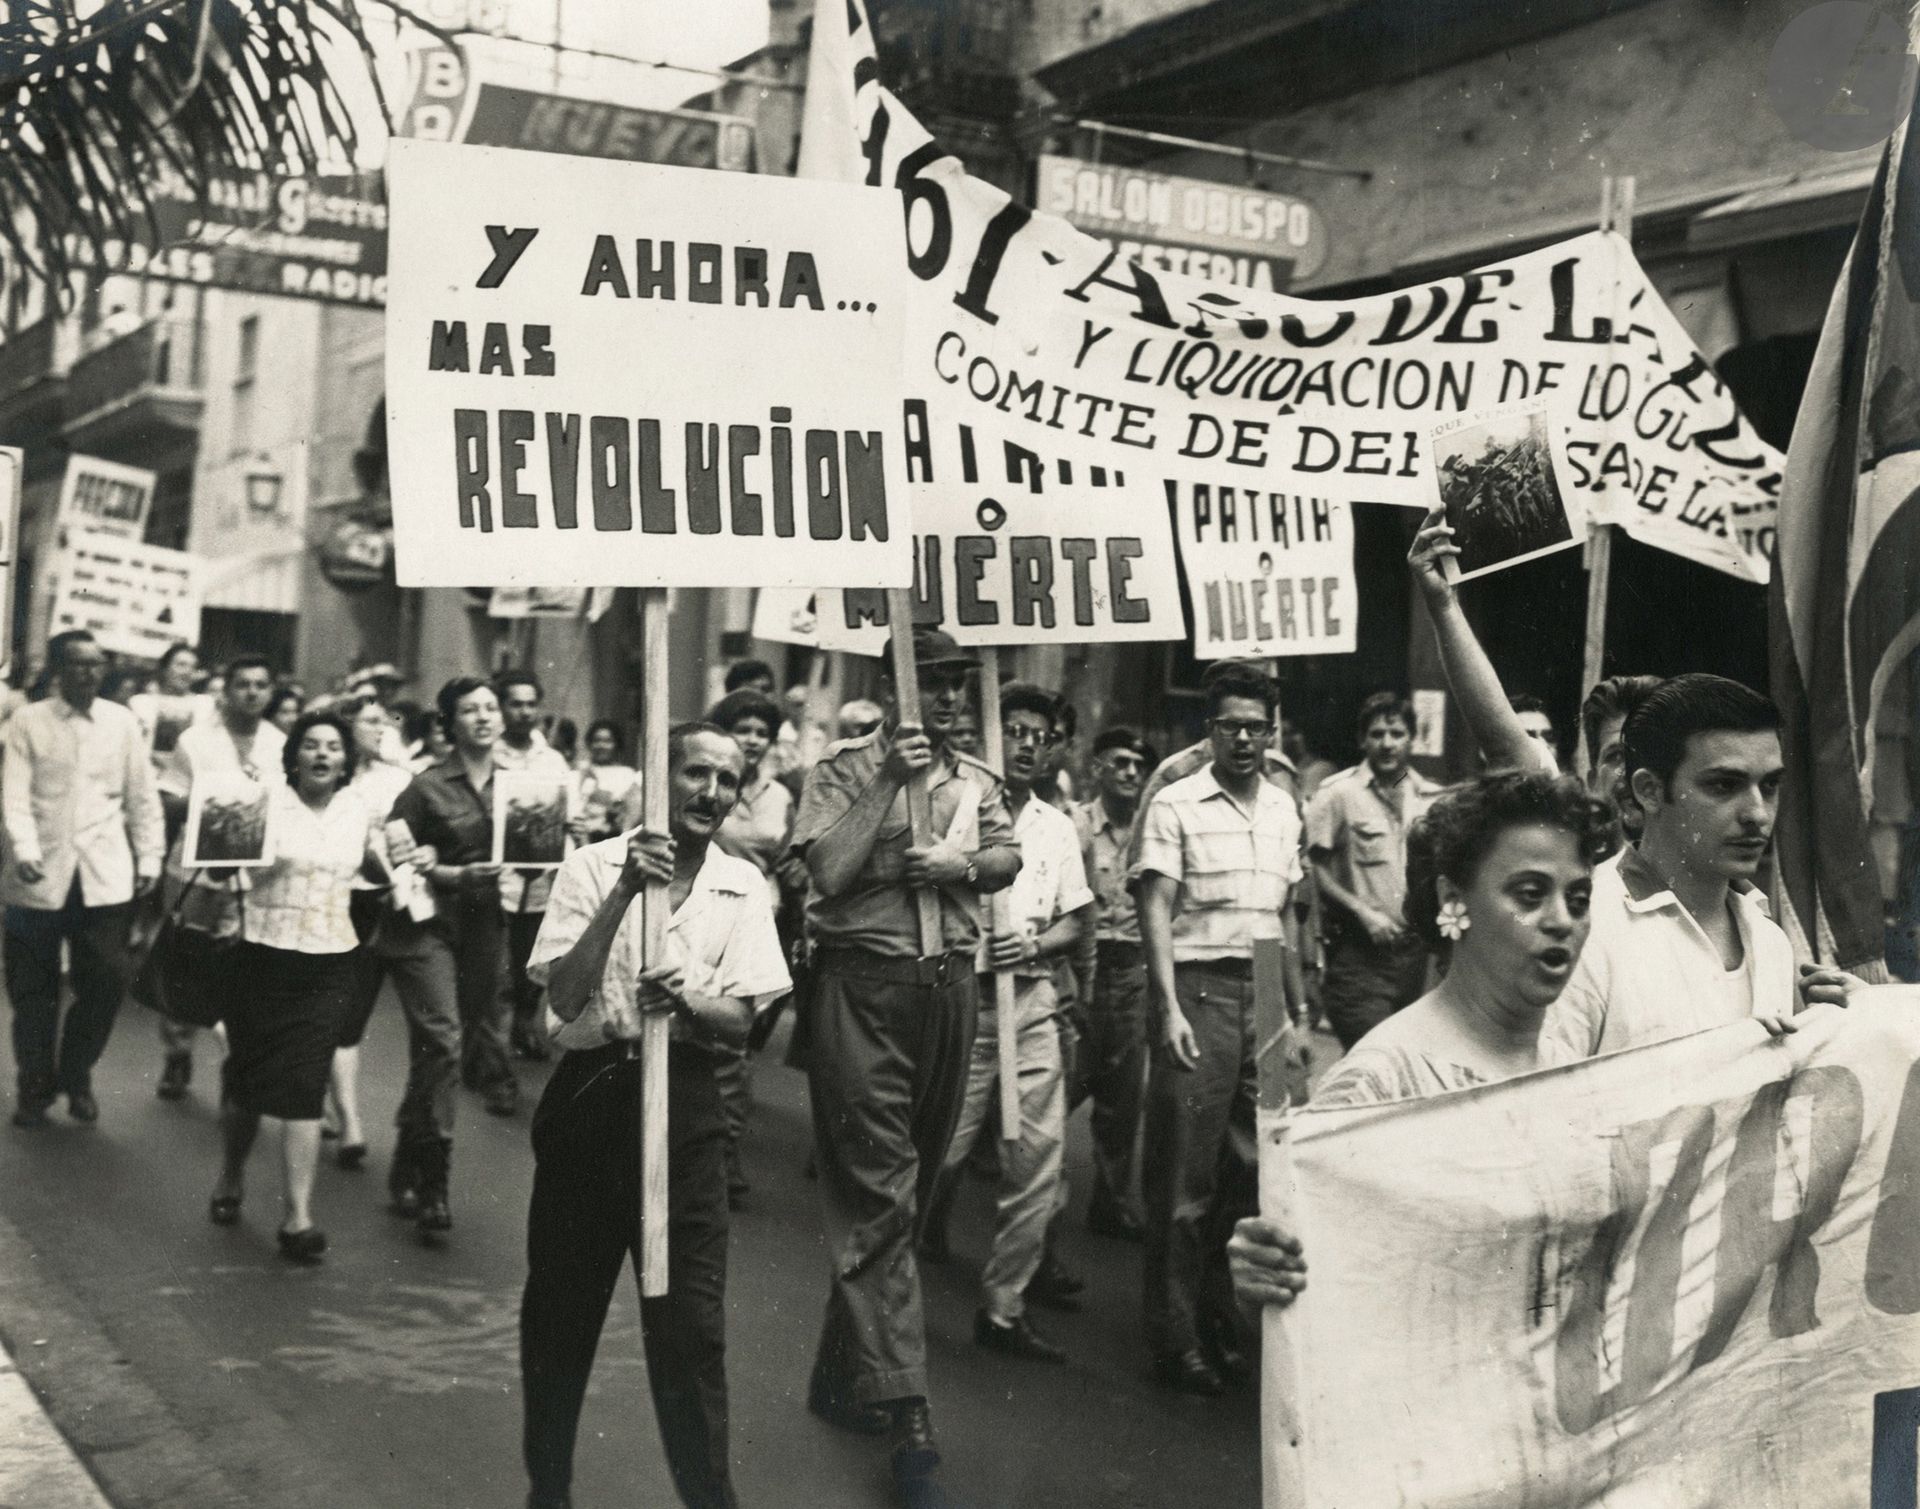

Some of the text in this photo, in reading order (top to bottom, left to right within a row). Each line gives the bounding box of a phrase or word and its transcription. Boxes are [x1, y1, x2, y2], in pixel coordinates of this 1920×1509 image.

[1050, 167, 1310, 247] SALON OBISPO
[475, 225, 877, 314] Y AHORA...
[428, 319, 556, 377] MAS
[1074, 319, 1114, 369] Y
[1124, 337, 1475, 412] LIQUIDACION
[934, 330, 1157, 450] COMITE
[1177, 412, 1270, 467] DE
[454, 405, 889, 543] REVOLUCION
[1193, 482, 1333, 550] PATRIA
